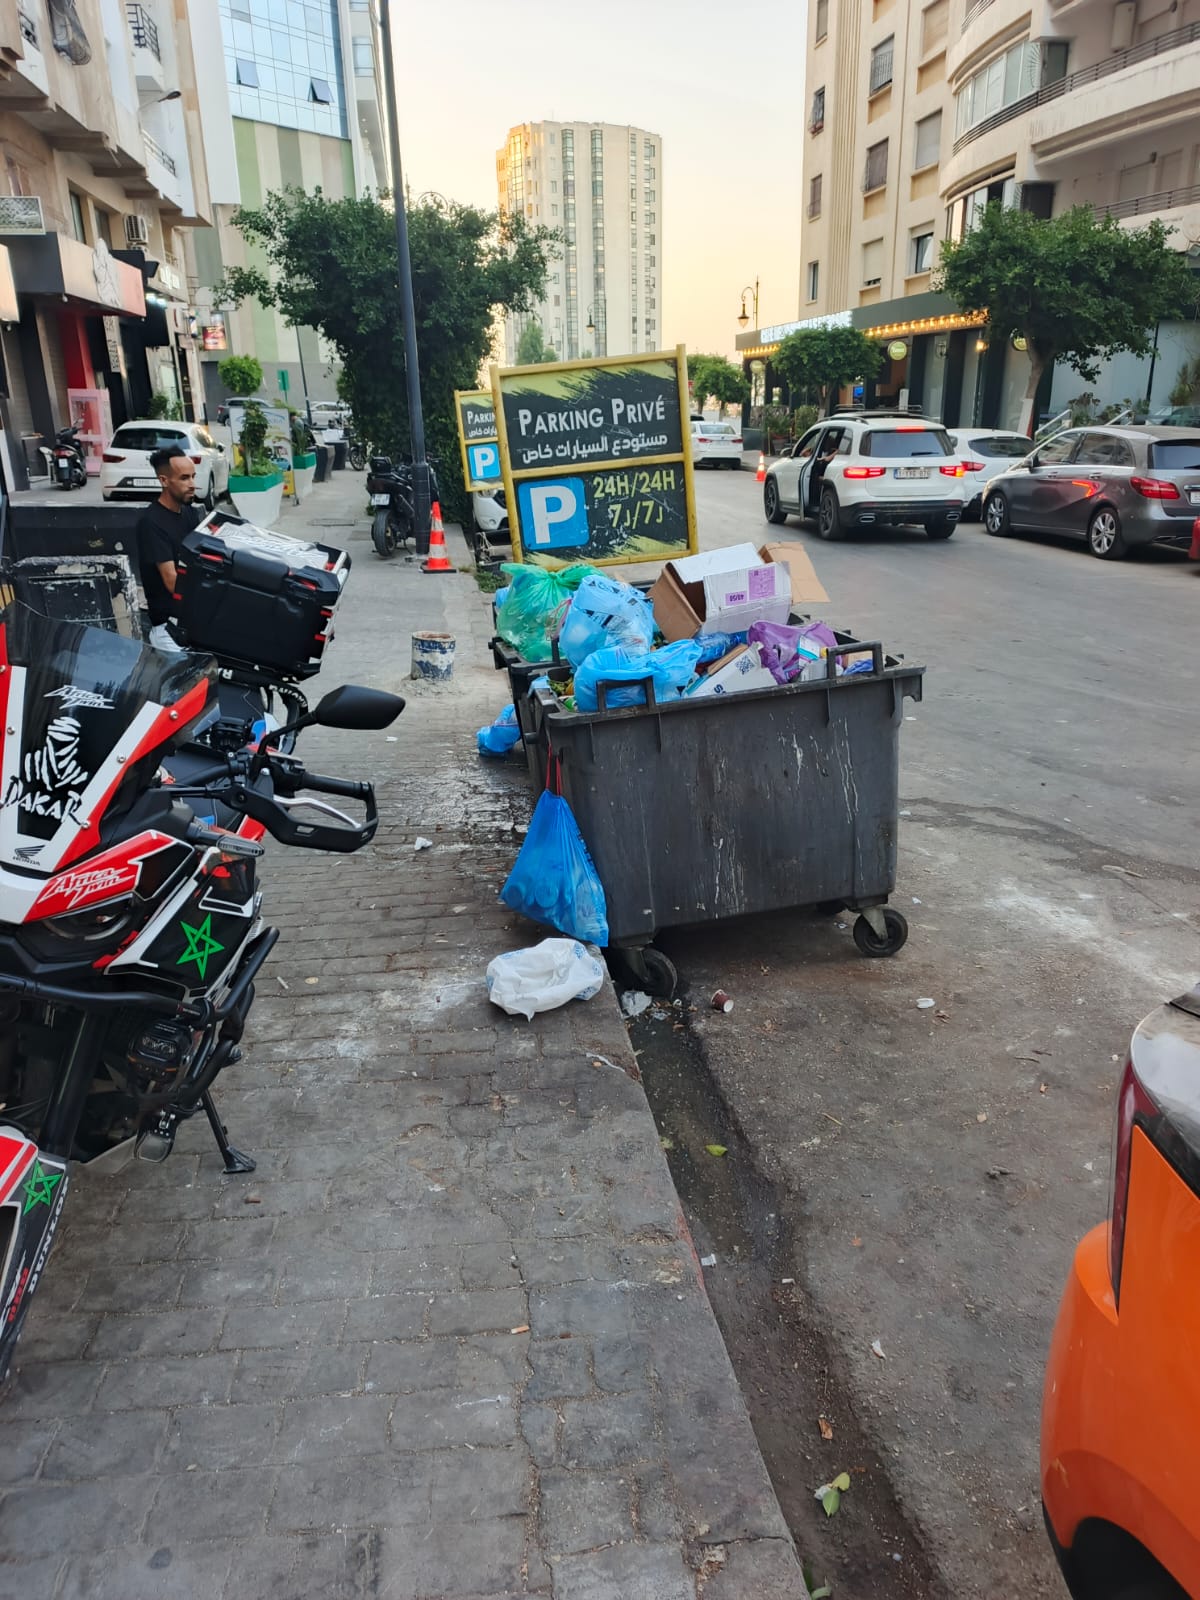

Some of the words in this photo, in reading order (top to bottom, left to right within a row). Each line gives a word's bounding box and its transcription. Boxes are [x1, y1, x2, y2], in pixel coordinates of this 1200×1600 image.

[518, 408, 604, 436] PARKING
[611, 394, 666, 425] PRIVÉ
[522, 442, 553, 464] خاص
[555, 434, 609, 459] السيارات
[611, 432, 668, 456] مستودع
[474, 447, 495, 477] P
[592, 469, 675, 498] 24H/24H
[530, 485, 577, 544] P
[4, 775, 83, 825] DAKAR
